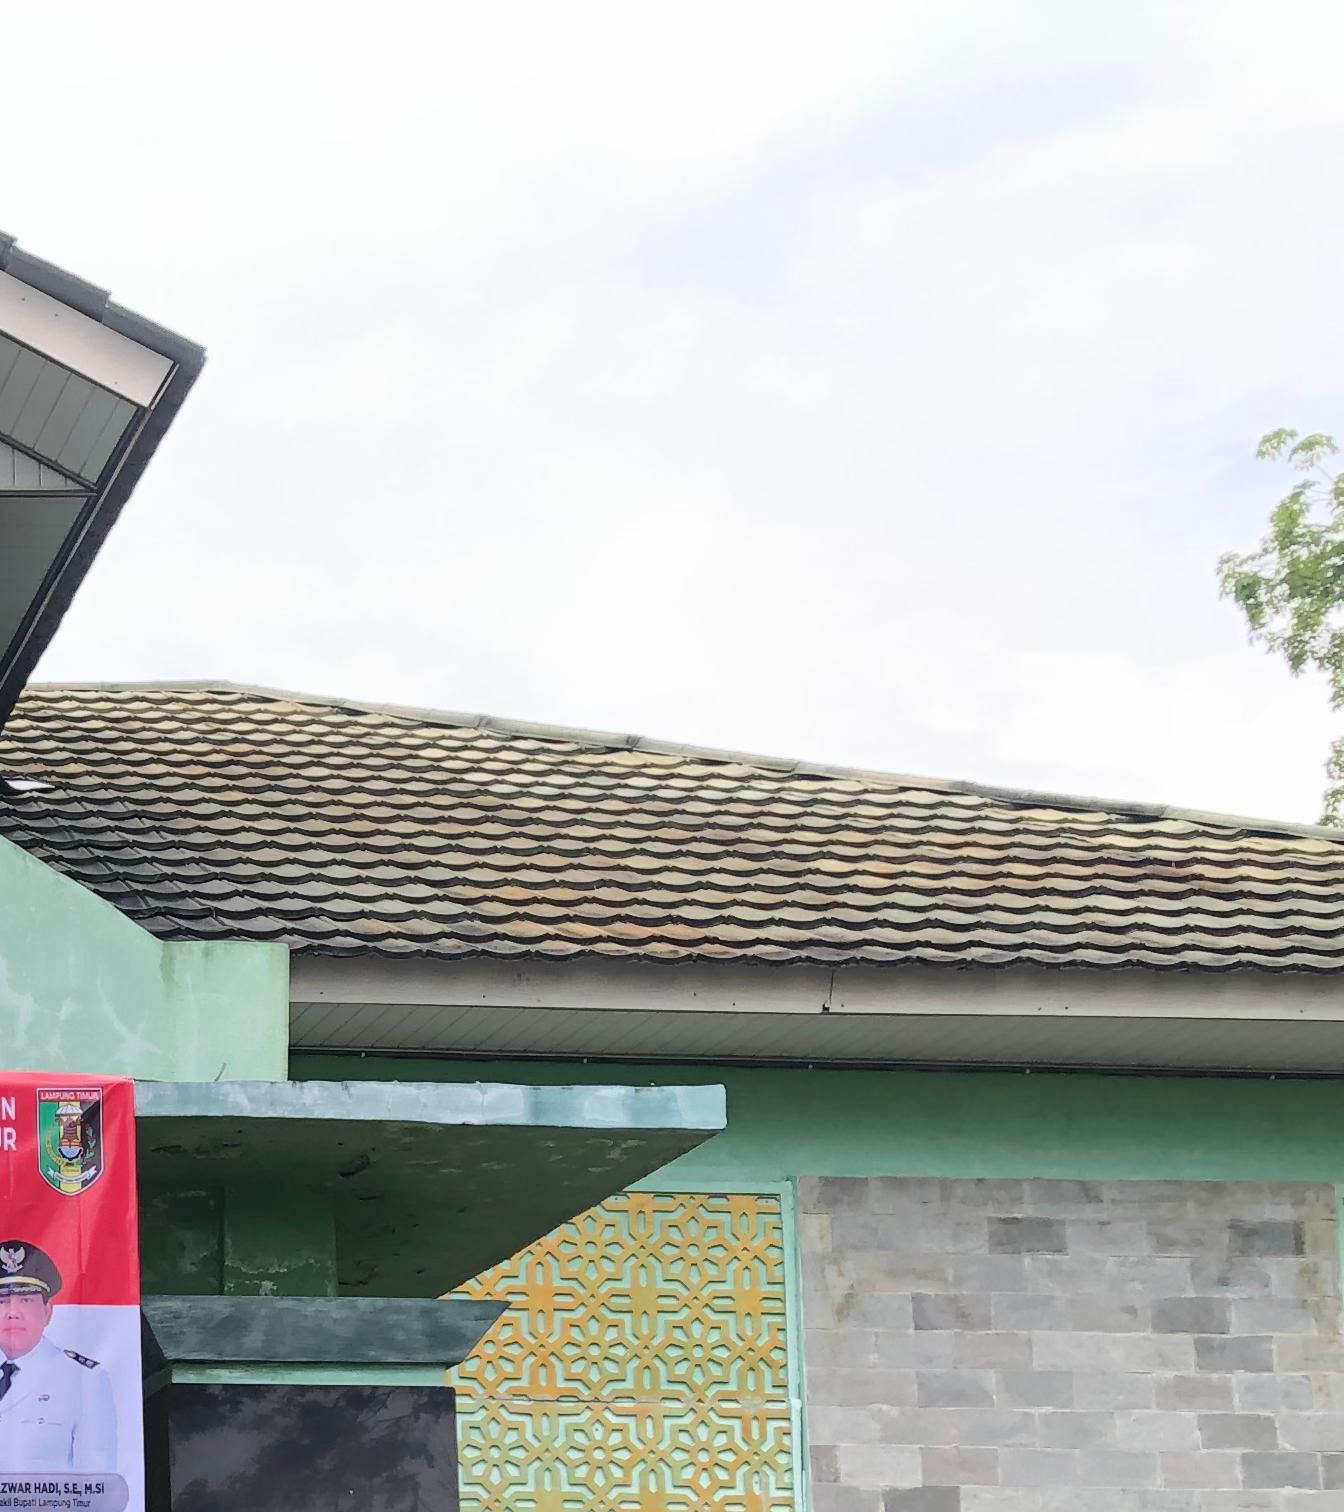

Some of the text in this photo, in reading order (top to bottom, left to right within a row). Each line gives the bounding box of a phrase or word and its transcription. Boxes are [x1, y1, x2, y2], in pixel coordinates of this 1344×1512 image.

[34, 1482, 62, 1497] HADI,
[84, 1482, 105, 1495] M.Si
[38, 1498, 71, 1509] Lampung
[72, 1498, 92, 1508] Timur
